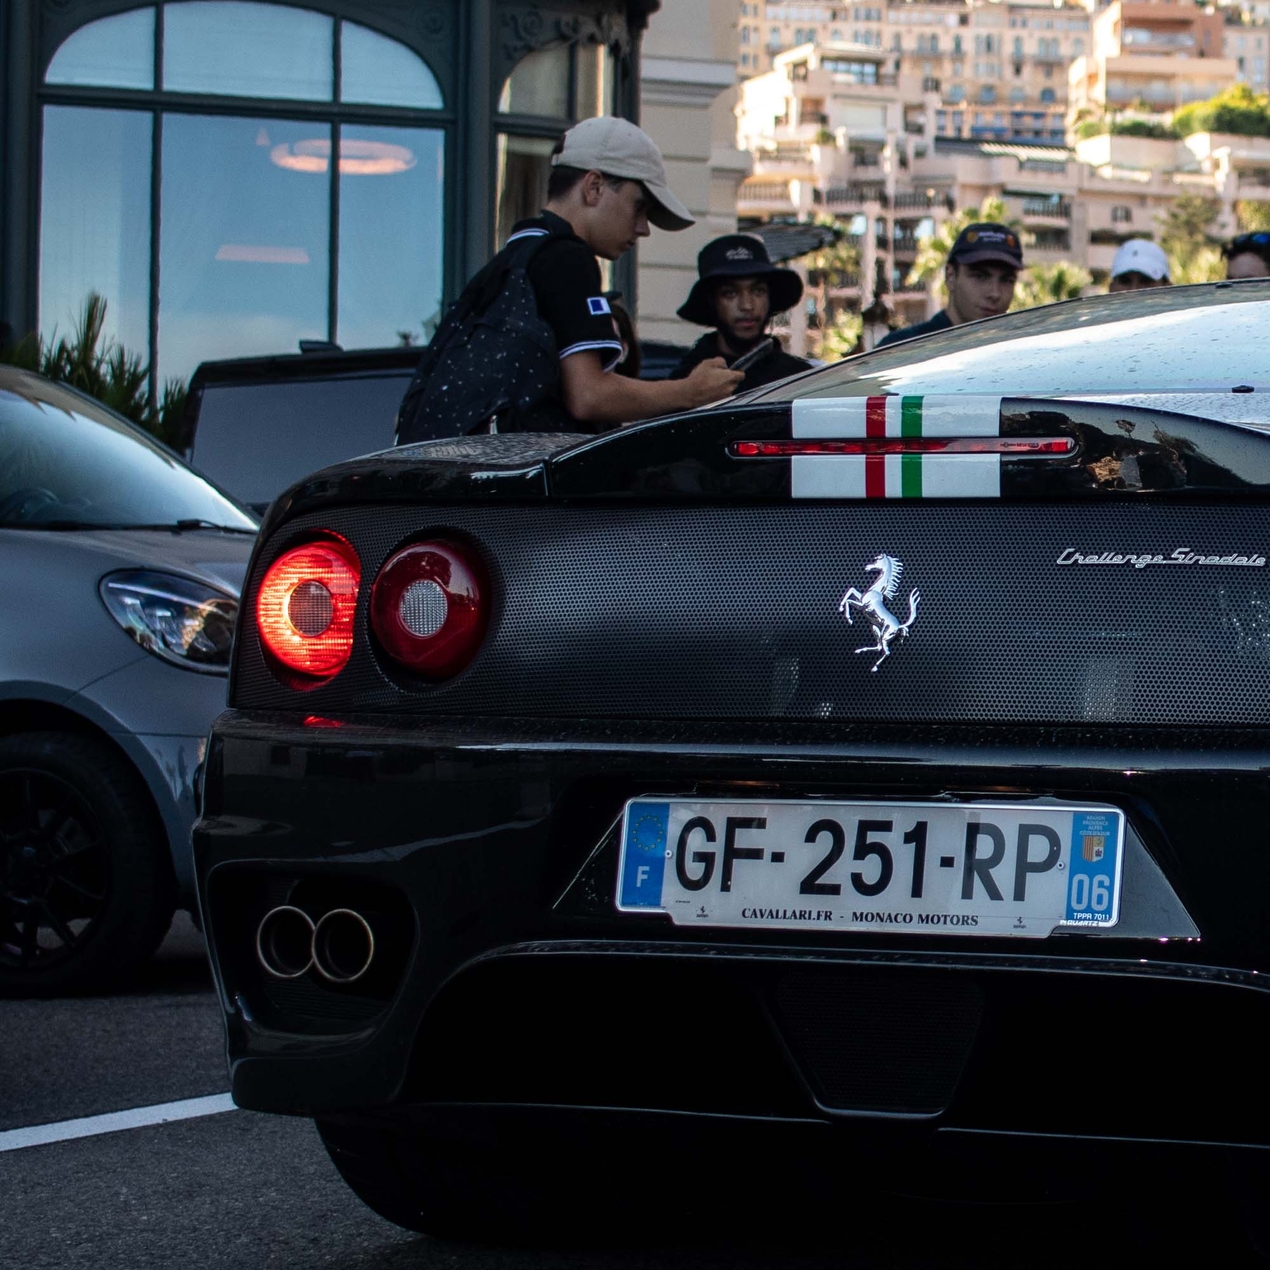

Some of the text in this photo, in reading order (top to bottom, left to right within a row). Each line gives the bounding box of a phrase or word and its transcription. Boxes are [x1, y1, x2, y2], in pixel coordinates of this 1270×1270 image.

[1056, 548, 1266, 568] Challenge Stradale
[675, 816, 1062, 901] GF-251-RP
[636, 866, 650, 887] F
[1071, 874, 1110, 911] 06
[741, 908, 833, 921] CAVALLARI.FR
[851, 911, 914, 924] MONACO
[917, 914, 979, 926] MOTORS
